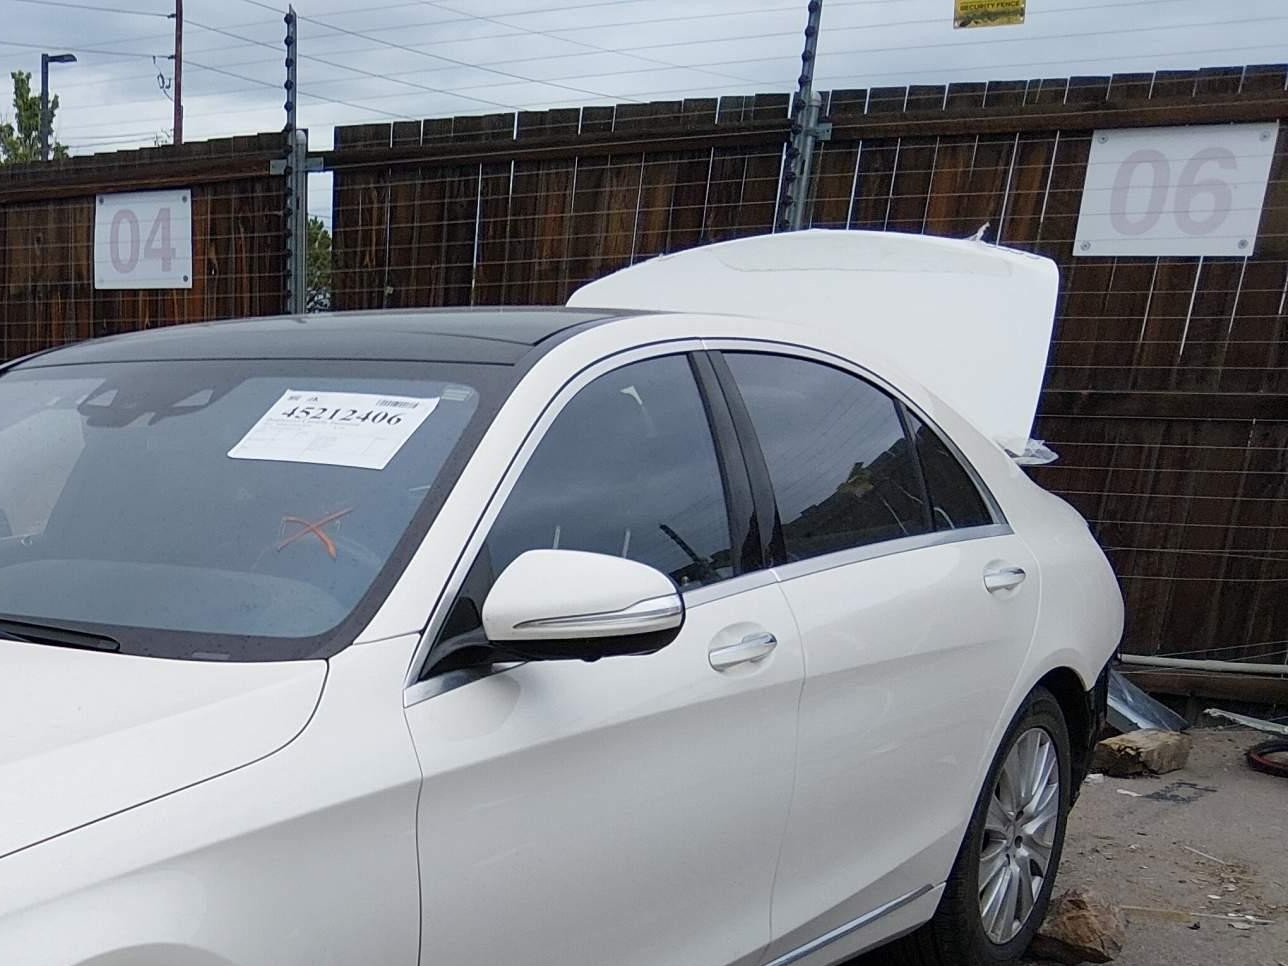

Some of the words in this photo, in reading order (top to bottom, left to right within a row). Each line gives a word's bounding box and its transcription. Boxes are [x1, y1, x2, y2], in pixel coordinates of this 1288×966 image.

[1110, 148, 1237, 235] 06
[109, 207, 176, 273] 04
[281, 405, 403, 425] 45212406
